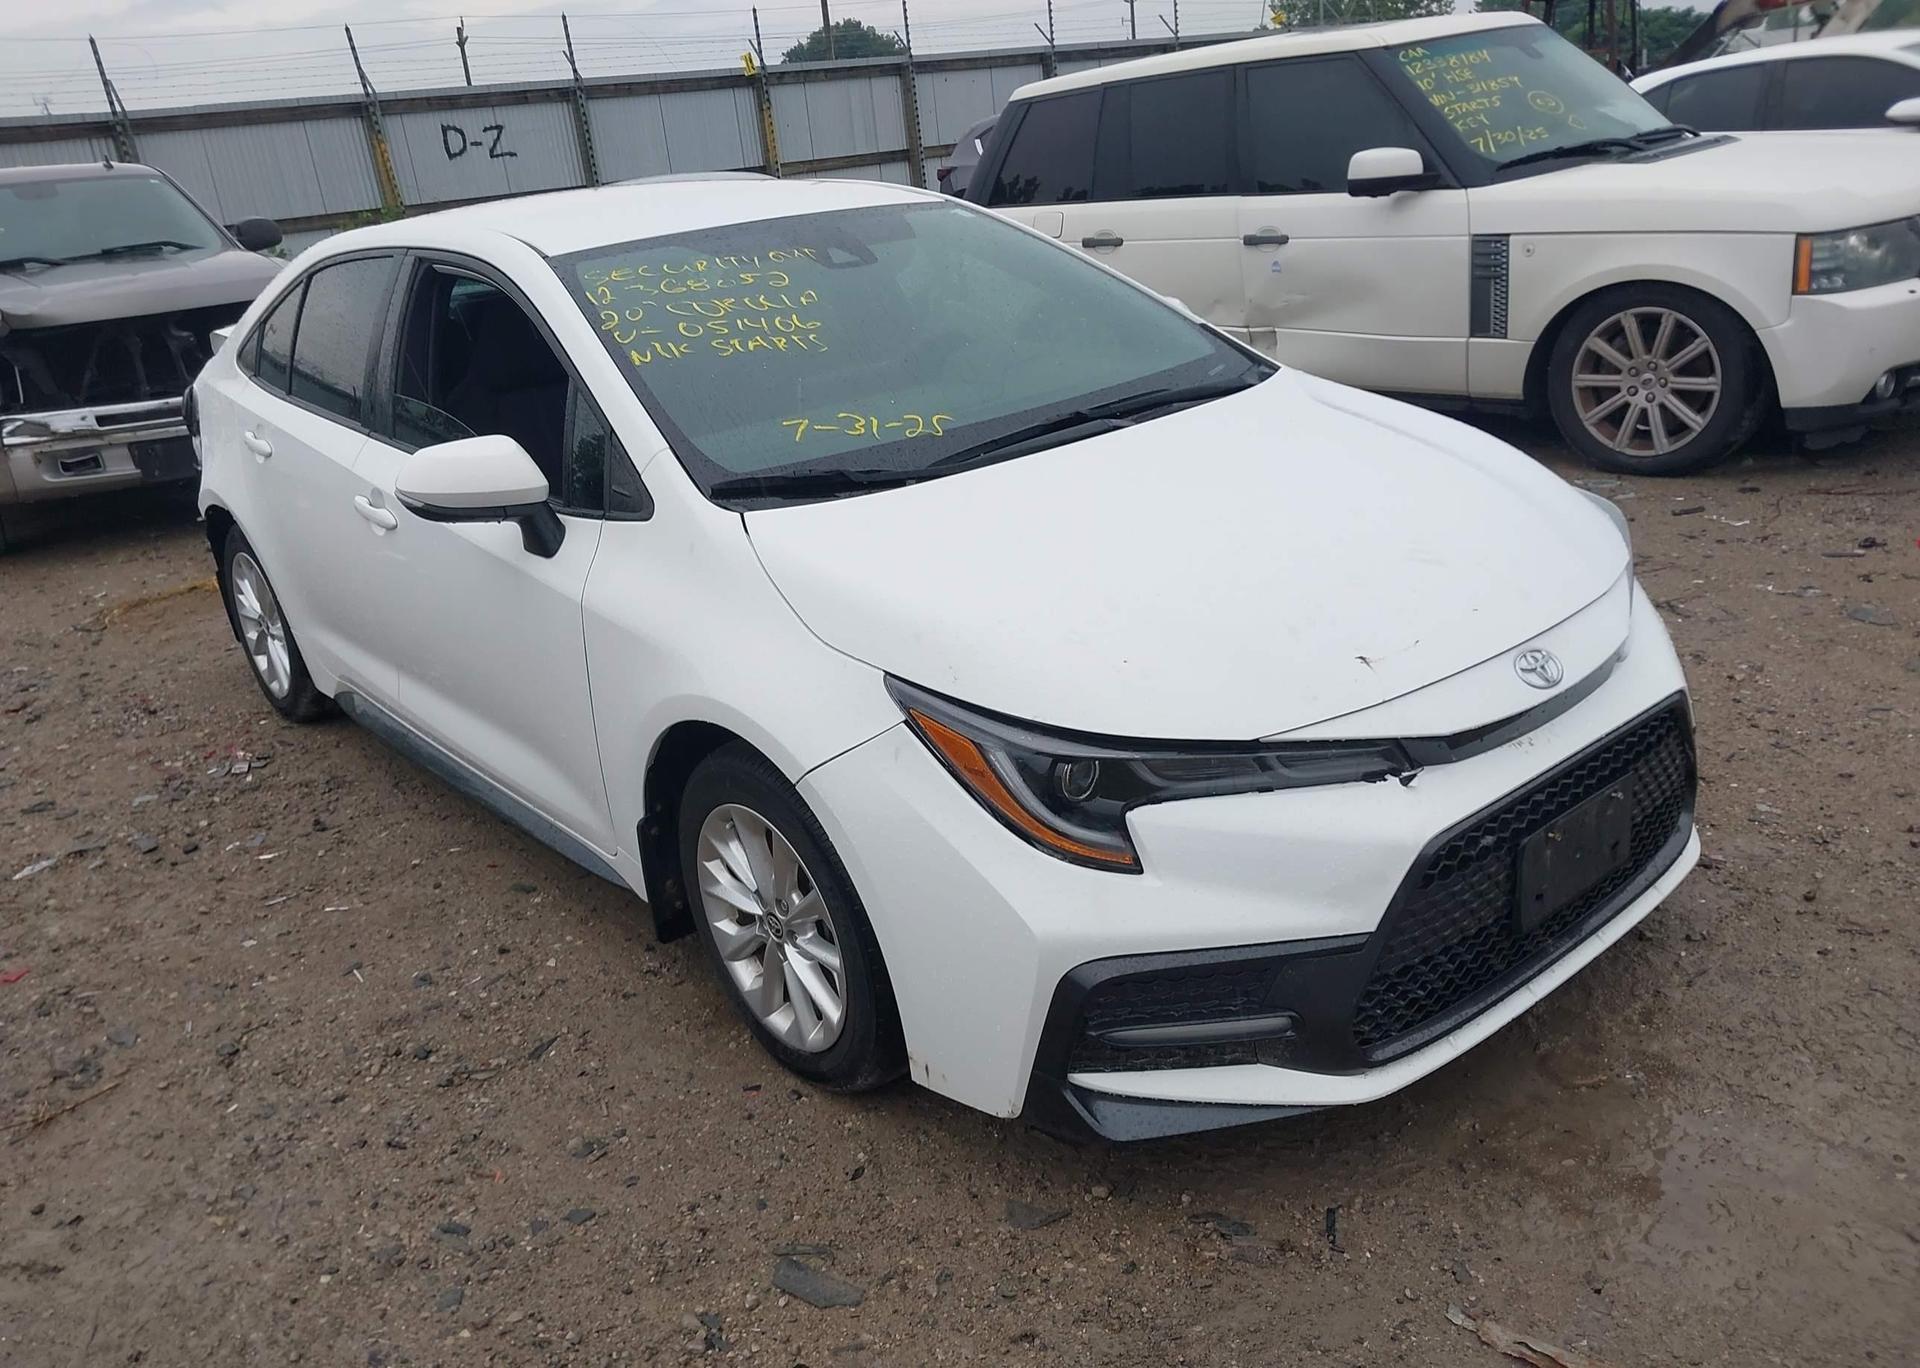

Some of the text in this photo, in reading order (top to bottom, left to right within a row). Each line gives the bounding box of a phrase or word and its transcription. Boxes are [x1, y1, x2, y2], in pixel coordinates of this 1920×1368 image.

[1443, 95, 1501, 120] STARTS
[1454, 113, 1490, 132] KEY
[1469, 125, 1550, 154] 7/30/25
[584, 255, 760, 285] SECURITY
[710, 333, 829, 357] STARTS
[782, 412, 956, 442] 7-31-25
